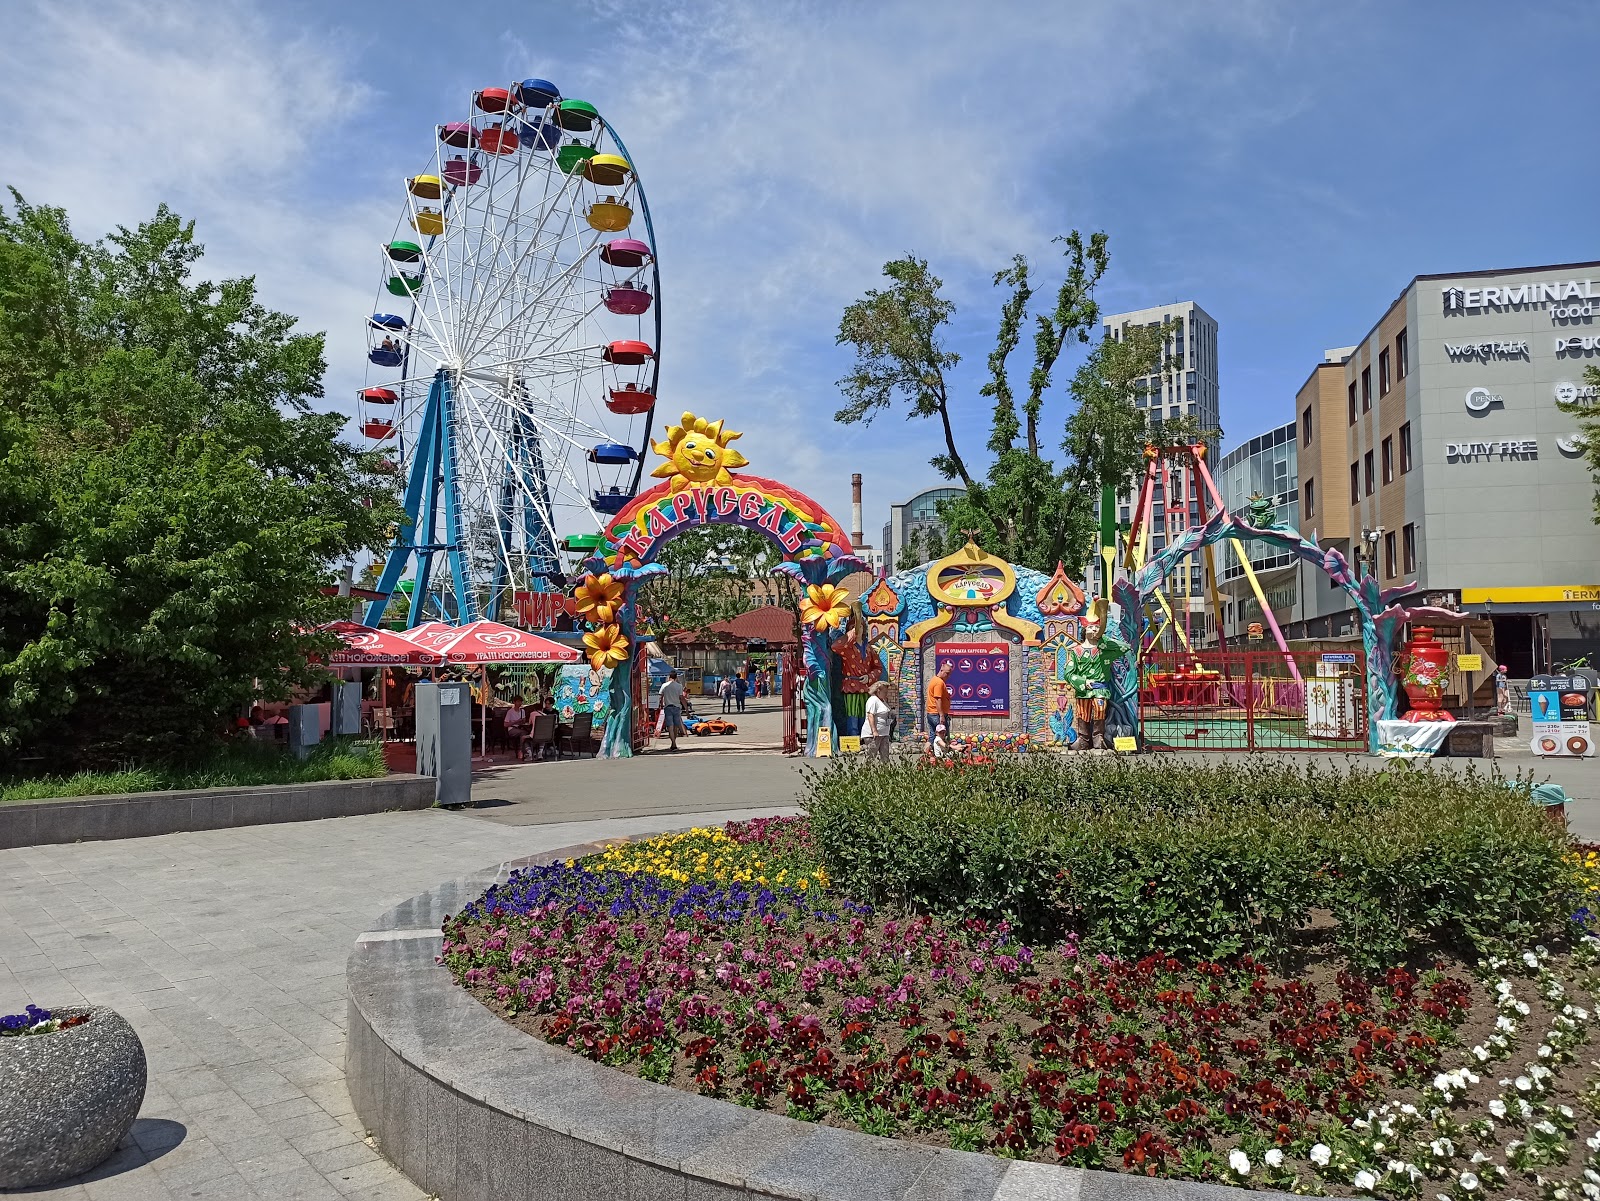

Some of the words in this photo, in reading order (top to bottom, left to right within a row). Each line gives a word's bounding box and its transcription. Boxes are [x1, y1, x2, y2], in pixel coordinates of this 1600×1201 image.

[1442, 279, 1600, 309] TERMINAL
[1550, 302, 1592, 319] food
[1446, 441, 1493, 457] DUTY
[1499, 439, 1538, 454] FREE
[622, 487, 808, 560] КАРУСЕЛЬ
[1562, 589, 1600, 599] TERM
[514, 591, 566, 628] ТИР
